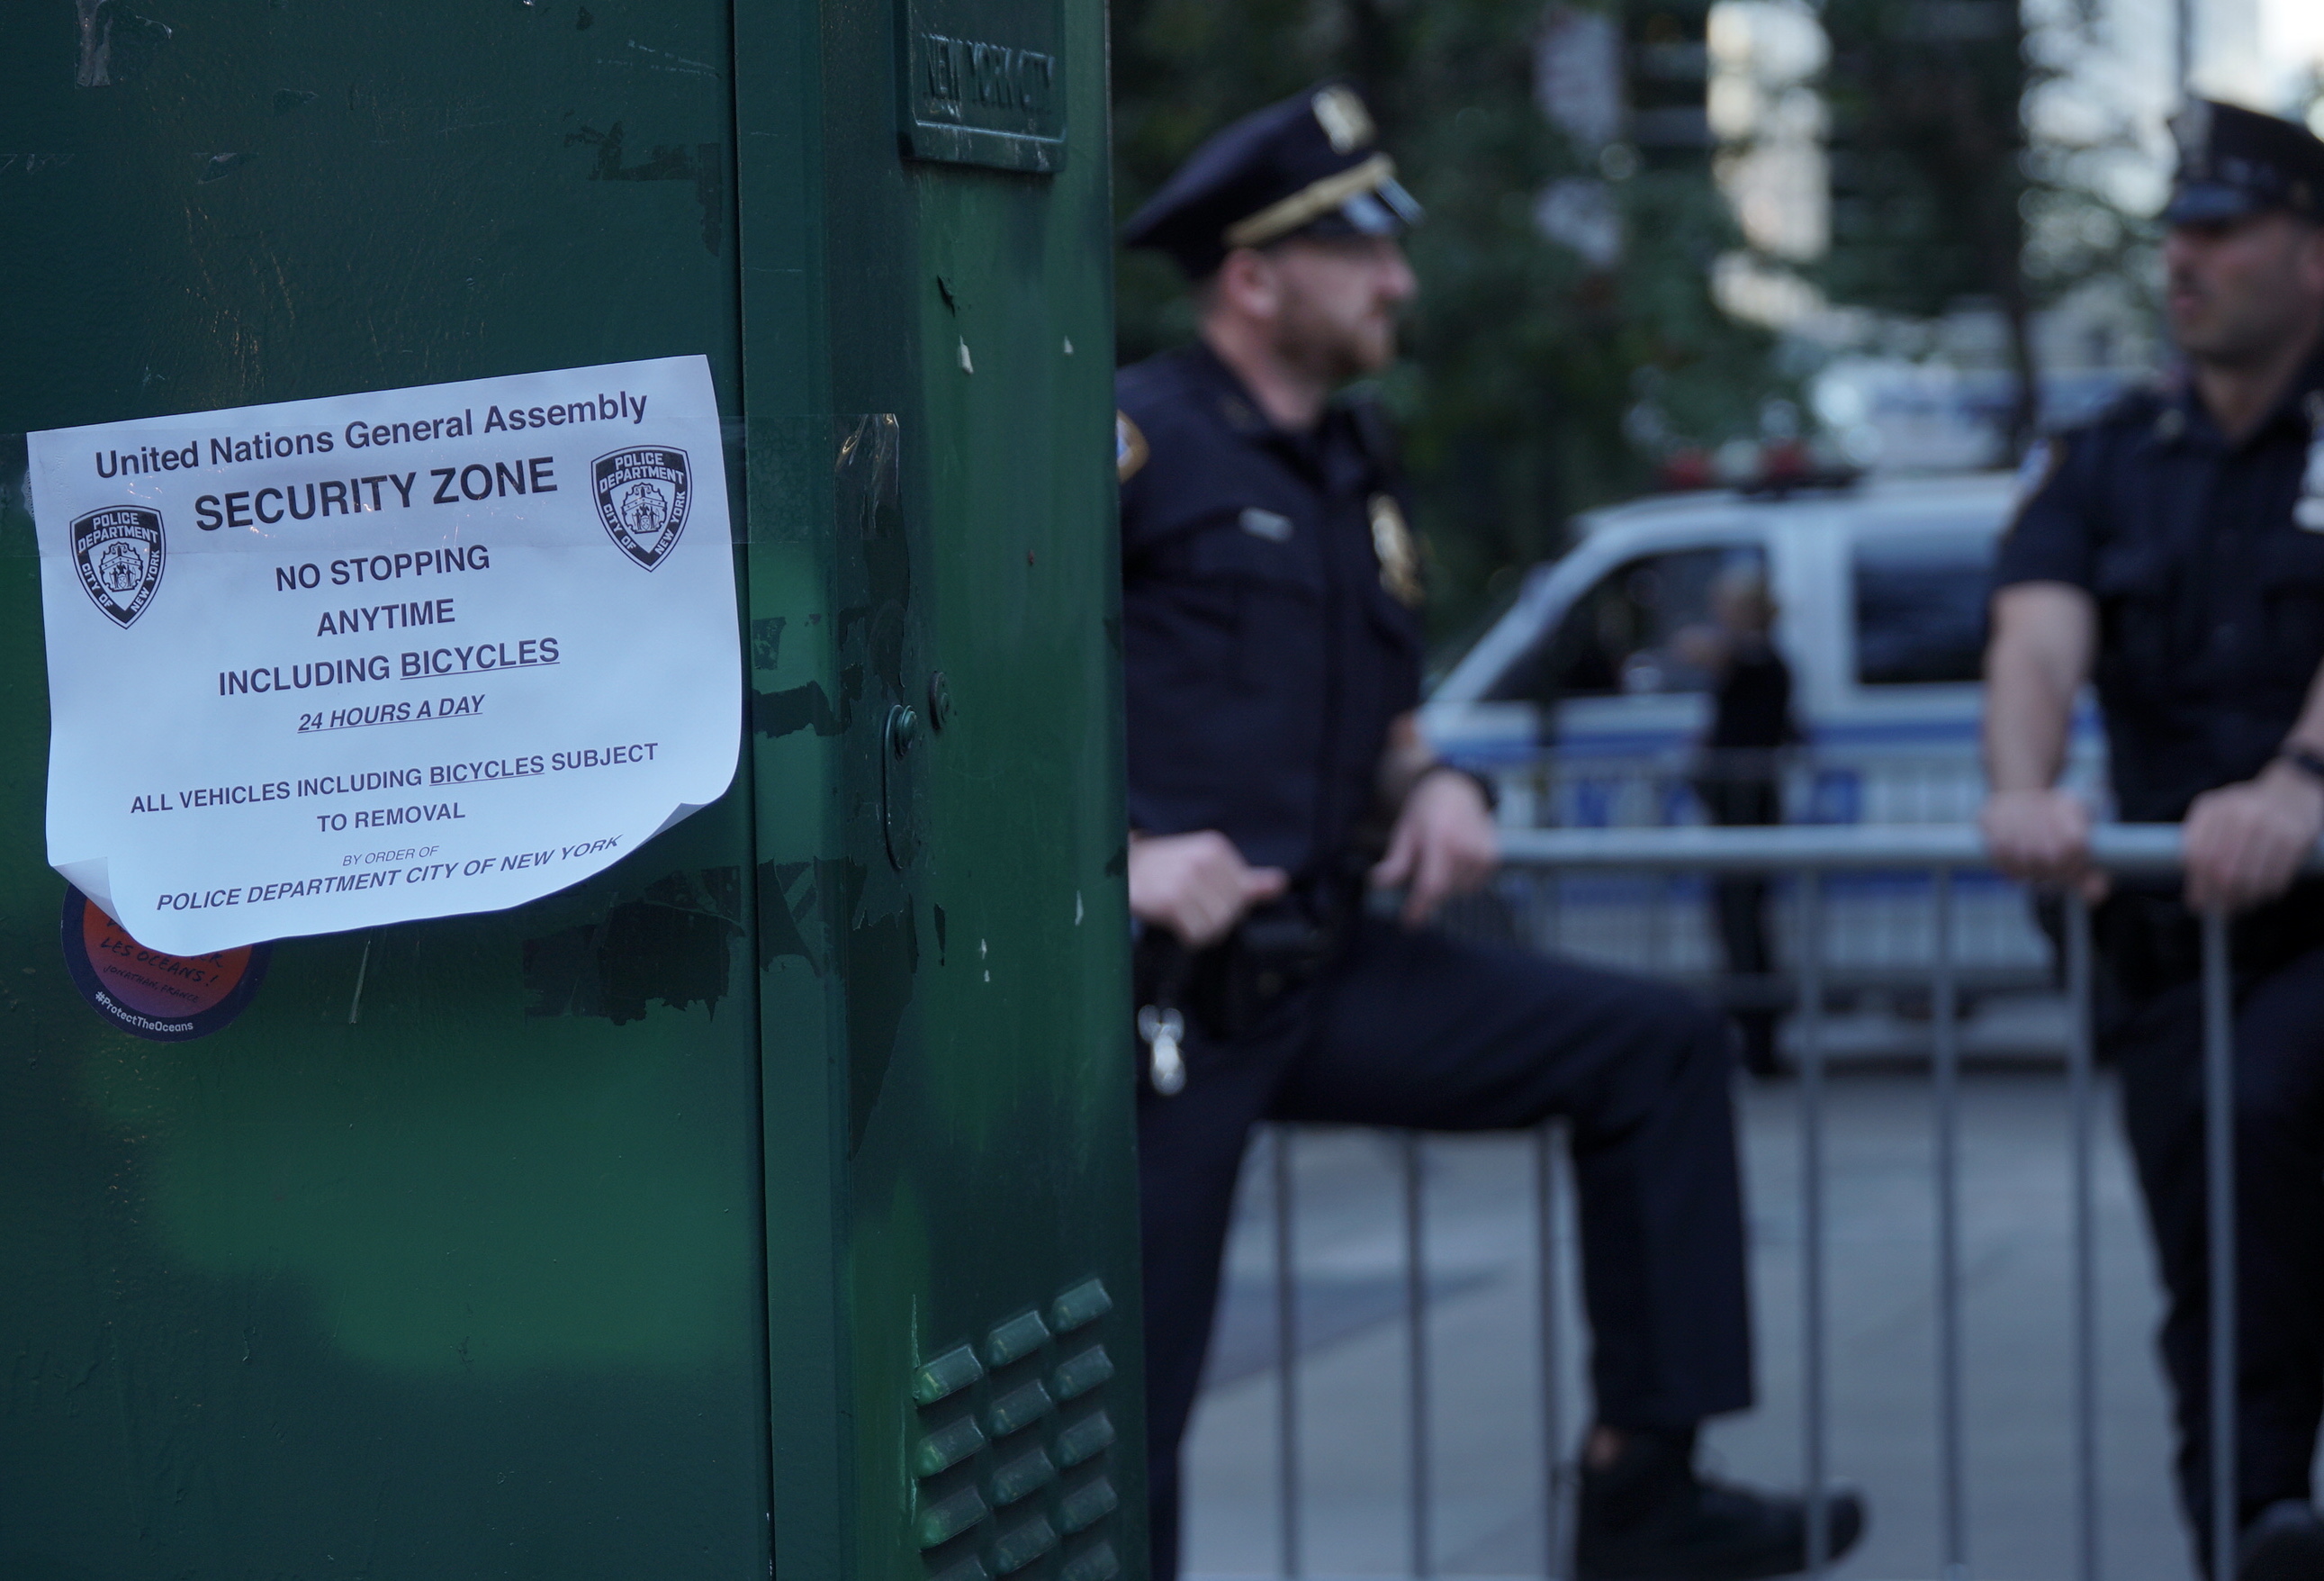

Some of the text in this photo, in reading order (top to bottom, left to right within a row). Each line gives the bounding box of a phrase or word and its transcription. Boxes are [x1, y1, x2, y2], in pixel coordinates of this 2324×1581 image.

[95, 390, 648, 479] United Nations General Assembly
[599, 465, 684, 493] DEPARTMENT
[615, 452, 664, 470] POLICE
[194, 456, 558, 532] SECURITY ZONE
[77, 525, 158, 554] DEPARTMENT
[93, 512, 140, 530] POLICE
[603, 503, 636, 550] CITY OF
[654, 491, 686, 555] NEW YORK
[81, 563, 113, 609] CITY OF
[130, 549, 160, 612] NEW YORK
[275, 544, 491, 592] NO STOPPING
[317, 598, 455, 637] ANYTIME
[219, 637, 560, 696] INCLUDING BICYCLES
[297, 693, 486, 732] 24 HOURS A DAY
[130, 742, 659, 814] ALL VEHICLES INCLUDING BICYCLES SUBJECT
[316, 801, 466, 833] TO REMOVAL
[156, 833, 625, 911] POLICE DEPARTMENT CITY OF NEW YORK
[342, 845, 440, 867] BY ORDER OF
[100, 936, 134, 957] LES
[103, 964, 200, 1004] JONATHAN, FRANCE
[95, 990, 194, 1033] #ProtectTheOceans
